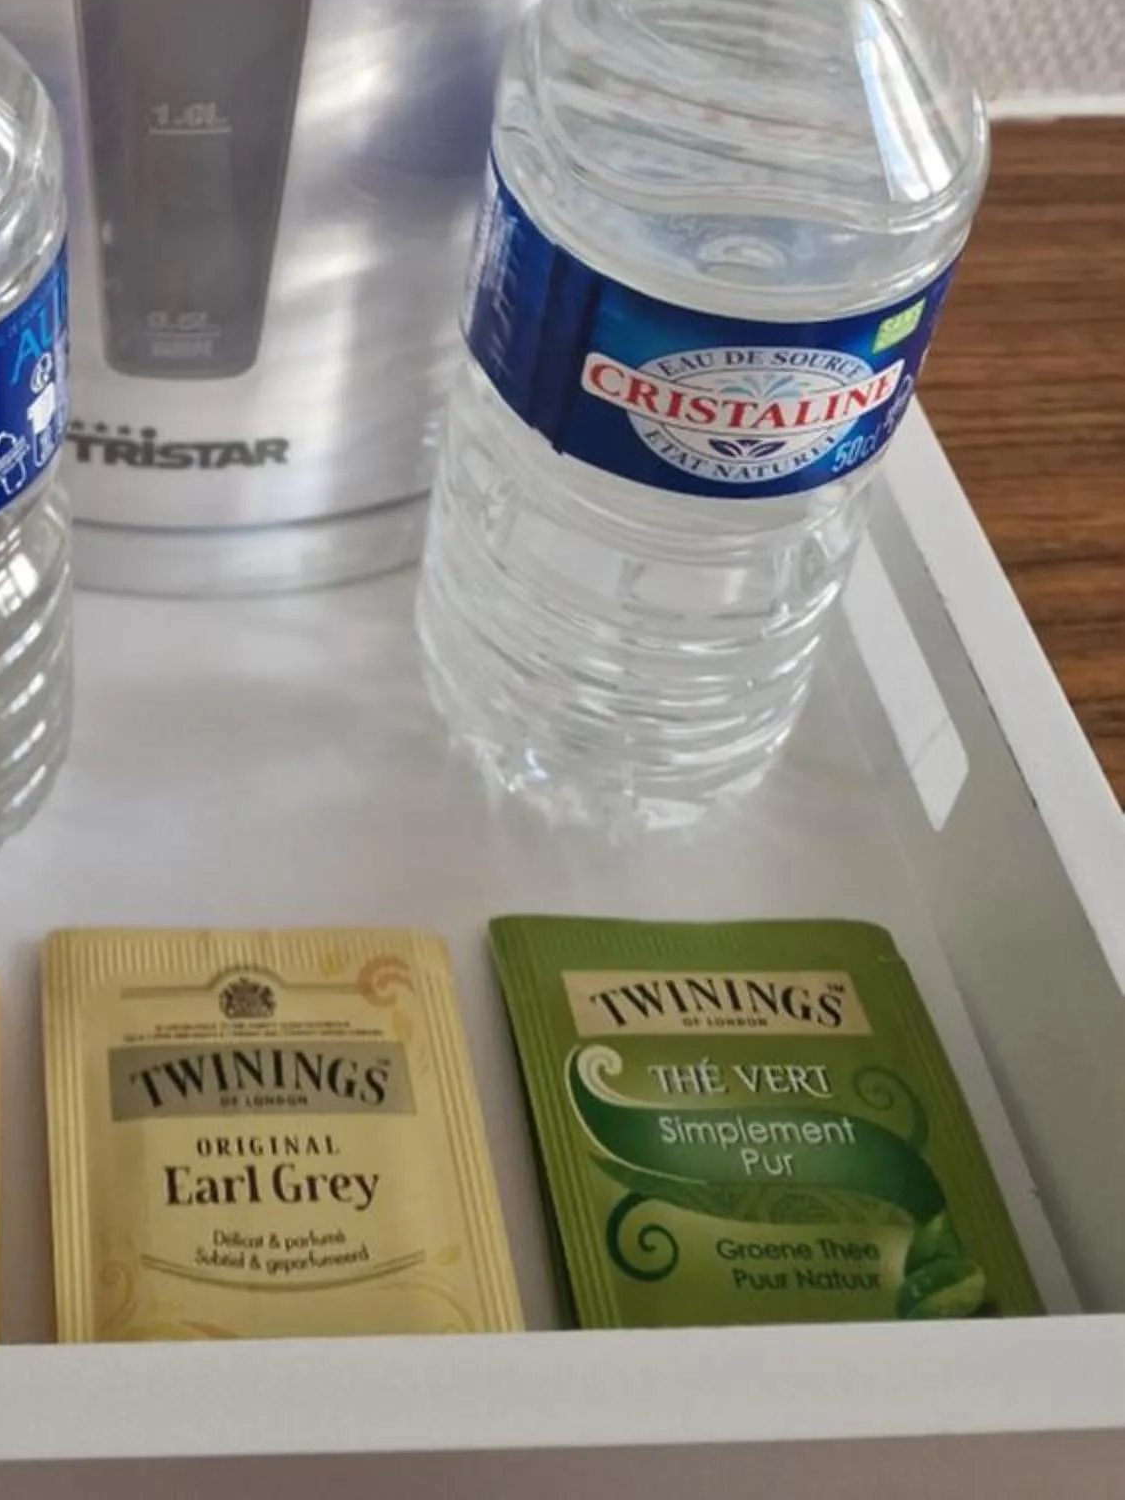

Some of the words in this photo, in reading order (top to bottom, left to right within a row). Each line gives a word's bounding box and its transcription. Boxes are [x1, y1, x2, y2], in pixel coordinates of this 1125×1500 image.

[657, 351, 713, 377] EAU
[724, 350, 764, 367] DE
[774, 351, 863, 379] SOURCE
[589, 363, 897, 429] CRISTALINE
[589, 977, 843, 1029] TWININGS
[129, 1049, 389, 1108] TWININGS
[648, 1055, 727, 1095] THÉ
[733, 1065, 834, 1099] VERT
[196, 1134, 342, 1158] ORIGINAL
[659, 1115, 856, 1151] Simplement
[740, 1148, 794, 1177] Pur
[164, 1163, 263, 1207] Earl
[272, 1162, 380, 1212] Grey
[268, 1231, 281, 1250] &
[715, 1238, 813, 1262] Groene
[818, 1238, 881, 1262] Thee
[249, 1252, 262, 1271] &
[732, 1267, 788, 1290] Puur
[796, 1267, 881, 1291] Natuur
